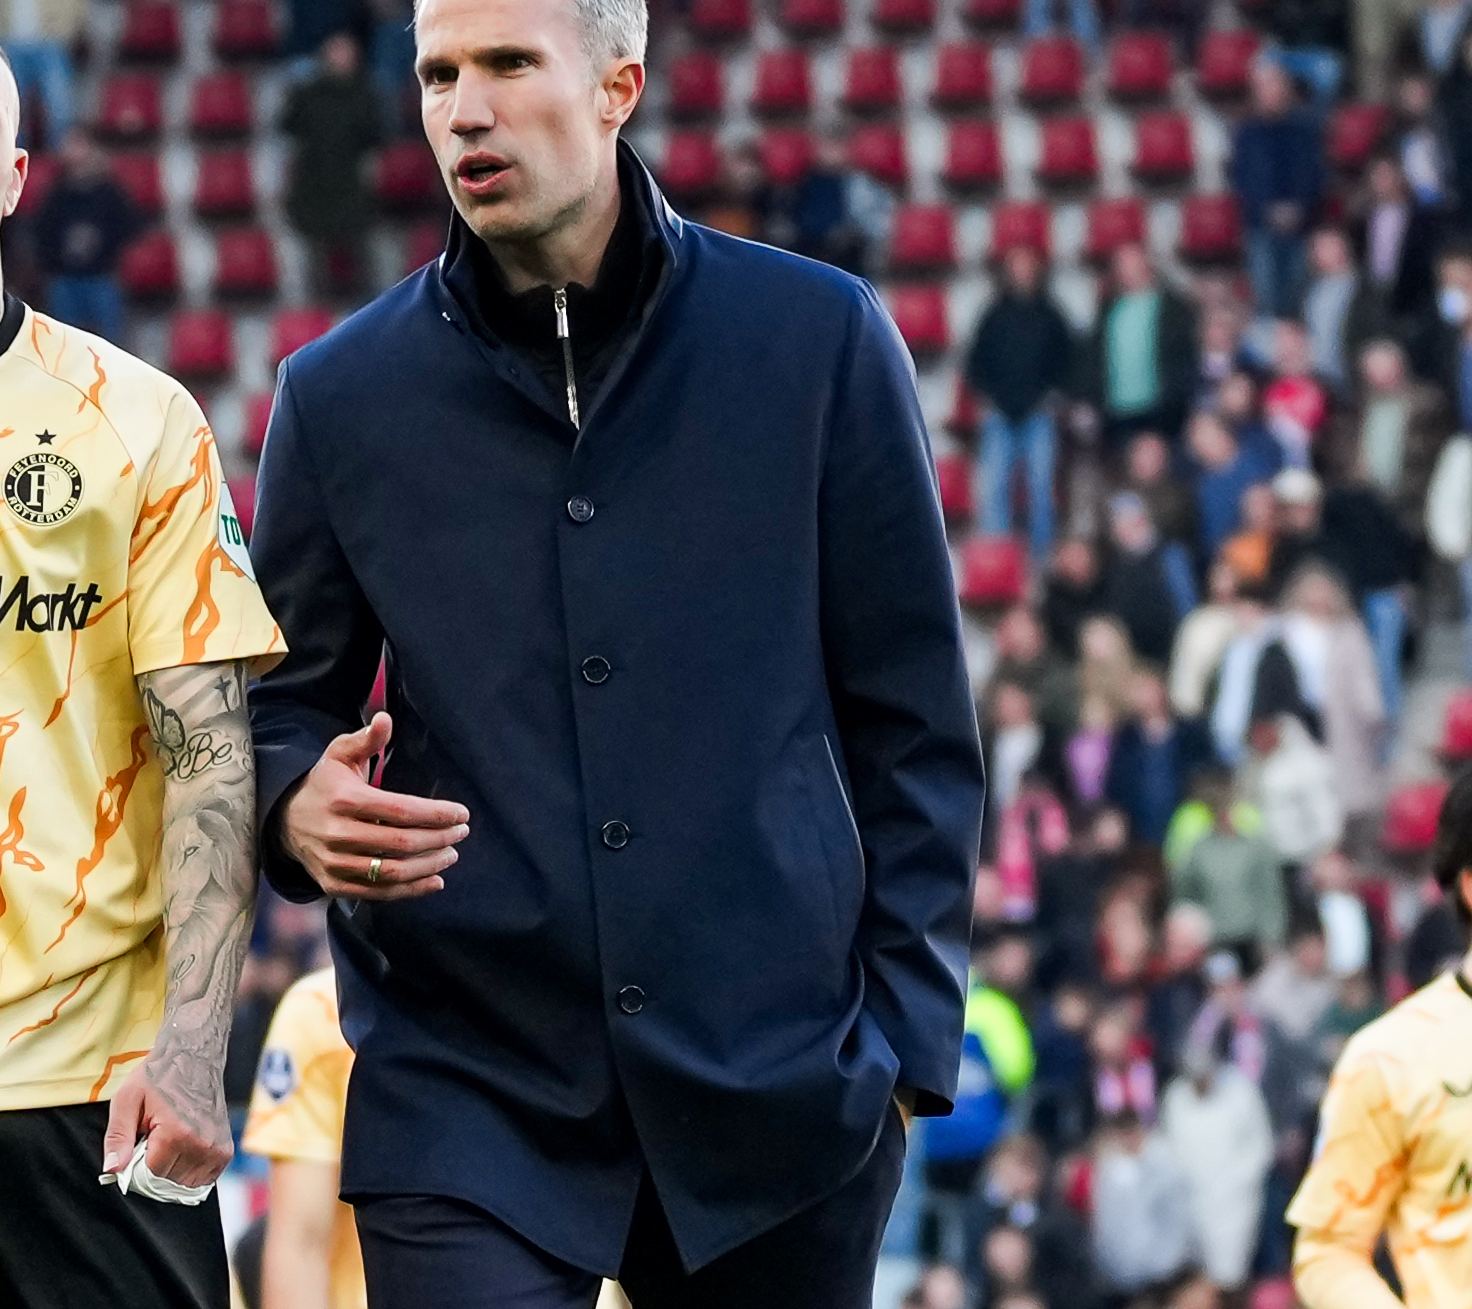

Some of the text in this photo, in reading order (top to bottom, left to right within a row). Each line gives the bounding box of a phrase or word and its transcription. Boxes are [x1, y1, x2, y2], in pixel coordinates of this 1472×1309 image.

[9, 454, 78, 478] FEYENOORD
[8, 496, 77, 523] ROTTERDAM
[177, 732, 233, 778] Be
